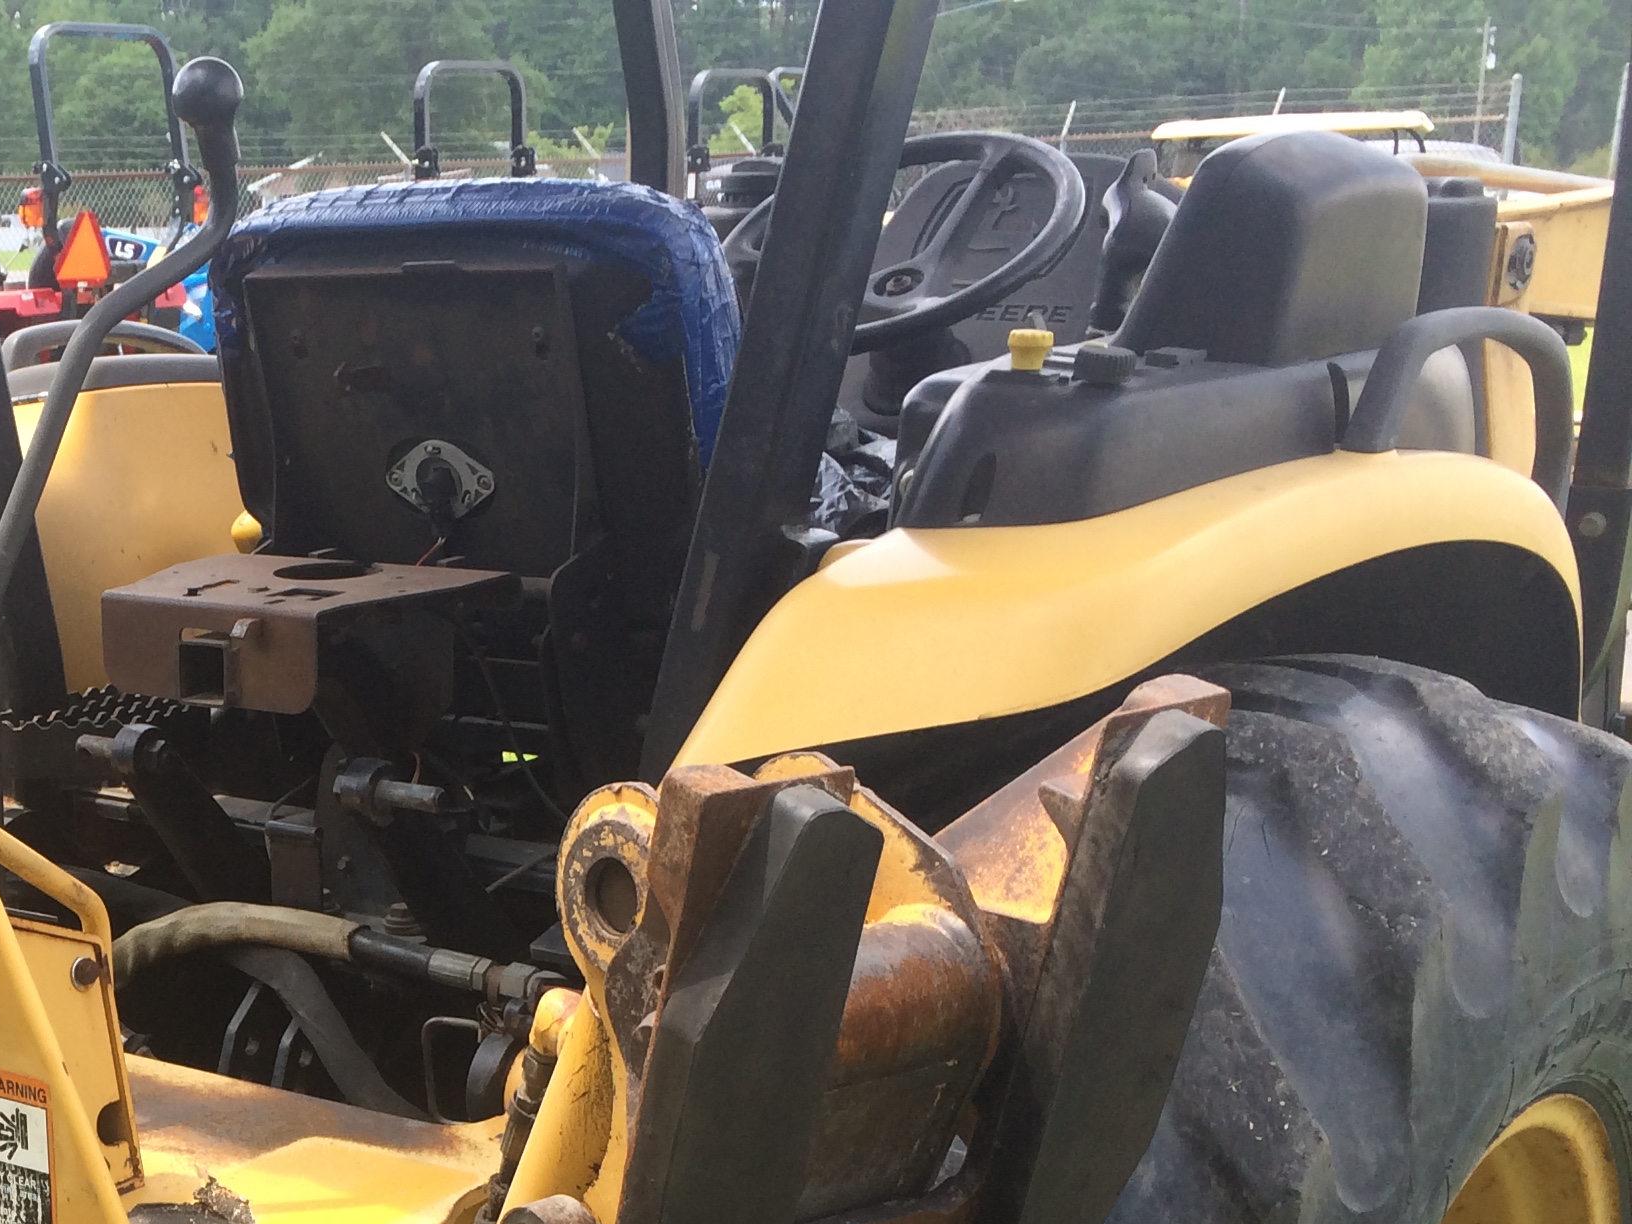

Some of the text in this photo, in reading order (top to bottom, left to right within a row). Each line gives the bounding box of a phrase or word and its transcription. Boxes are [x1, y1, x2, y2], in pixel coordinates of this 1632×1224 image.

[114, 240, 135, 259] LS
[975, 303, 1072, 323] EERE
[7, 1171, 37, 1190] CLEAR
